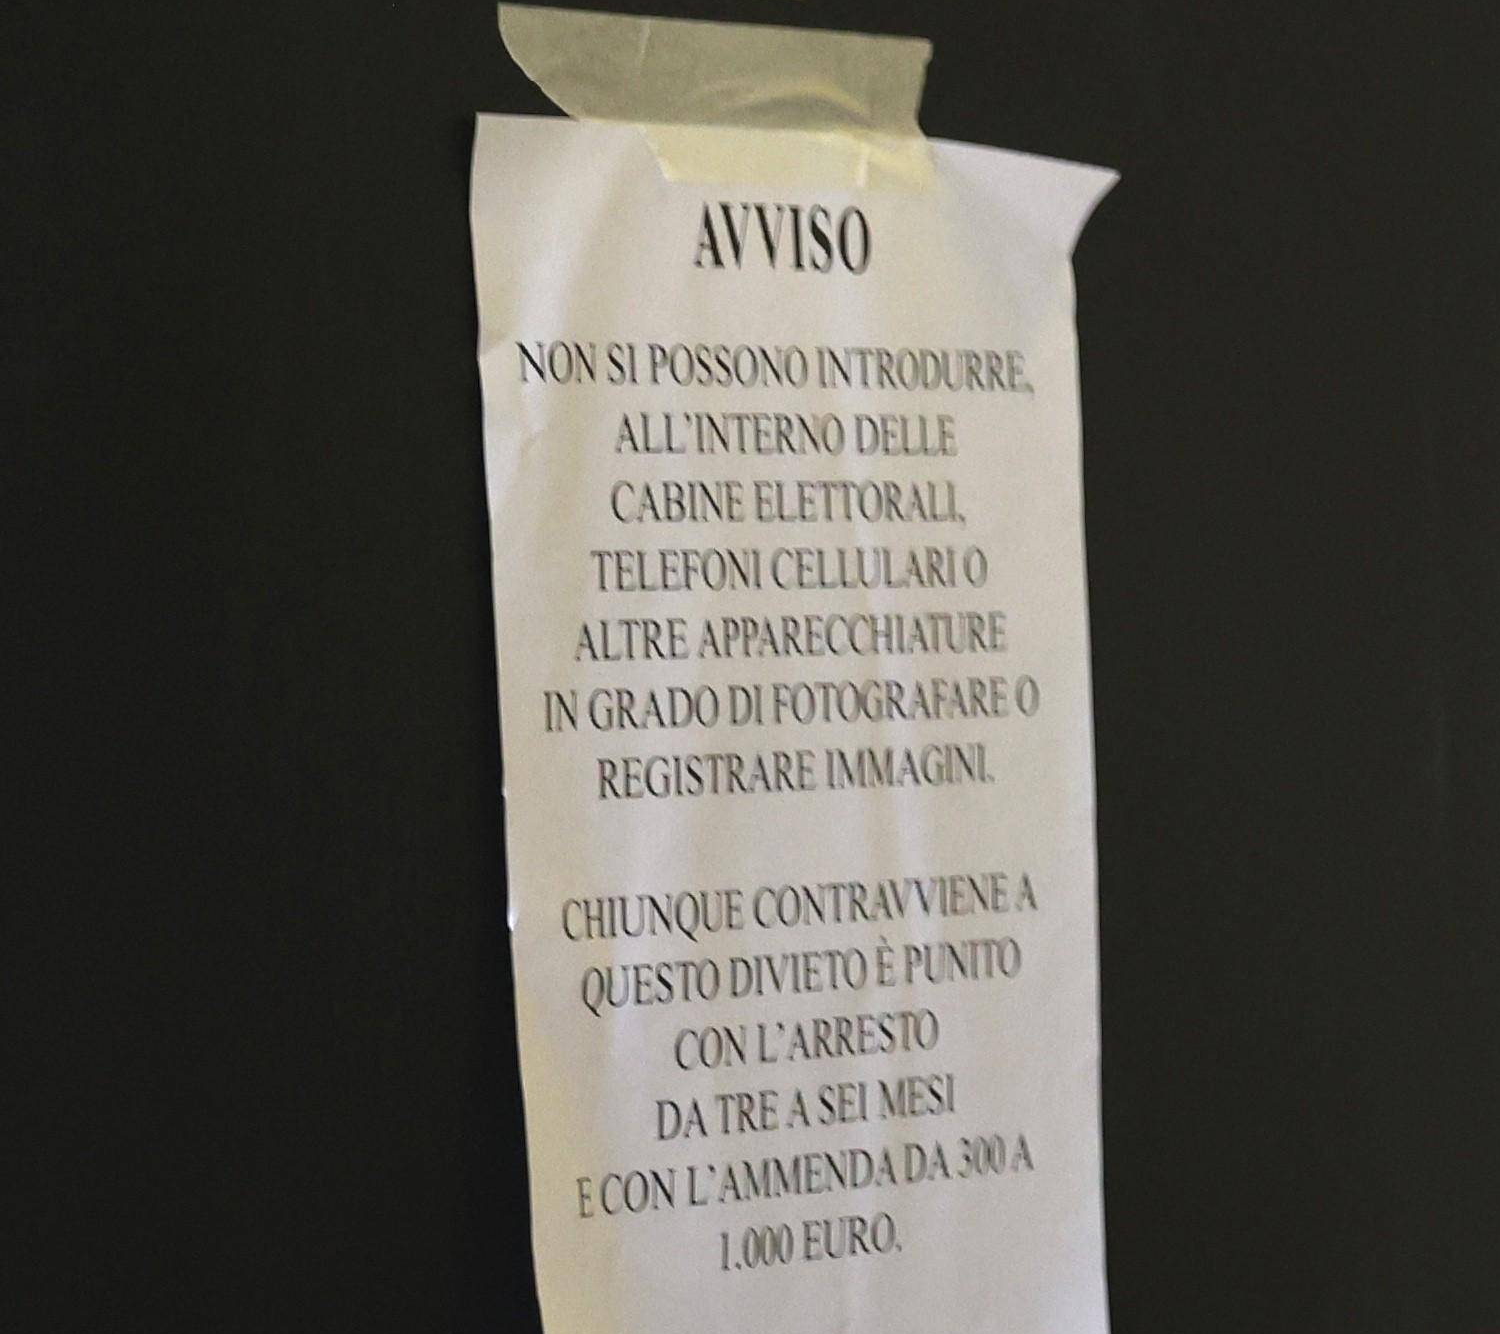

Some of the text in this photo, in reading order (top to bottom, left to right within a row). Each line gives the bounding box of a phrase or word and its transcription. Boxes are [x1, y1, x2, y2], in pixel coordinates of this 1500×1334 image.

[693, 202, 874, 277] AVVISO
[516, 341, 598, 385] NON
[607, 344, 638, 385] SI
[648, 346, 808, 389] POSSONO
[615, 412, 959, 456] ALL'INTERNO DELLE
[610, 481, 967, 526] CABINE ELETTORALI,
[590, 544, 989, 592] TELEFONI CELLULARI O
[575, 611, 1008, 662] ALTRE APPARECCHIATURE
[544, 673, 1041, 732] IN GRADO DI FOTOGRAFARE O
[598, 742, 997, 801] REGISTRARE IMMAGINI.
[561, 872, 1039, 942] CHIUNQUE CONTRAVVIENE A
[580, 936, 1023, 1017] QUESTO DIVIETO È PUNITO
[674, 1023, 747, 1071] CON
[655, 1071, 956, 1142] DA TRE A SEI MESI
[576, 1176, 595, 1218] E
[600, 1165, 676, 1215] CON
[903, 1140, 953, 1183] DA
[958, 1135, 1006, 1179] 300
[1011, 1131, 1035, 1173] A
[719, 1212, 903, 1272] 1.000 EURO.
